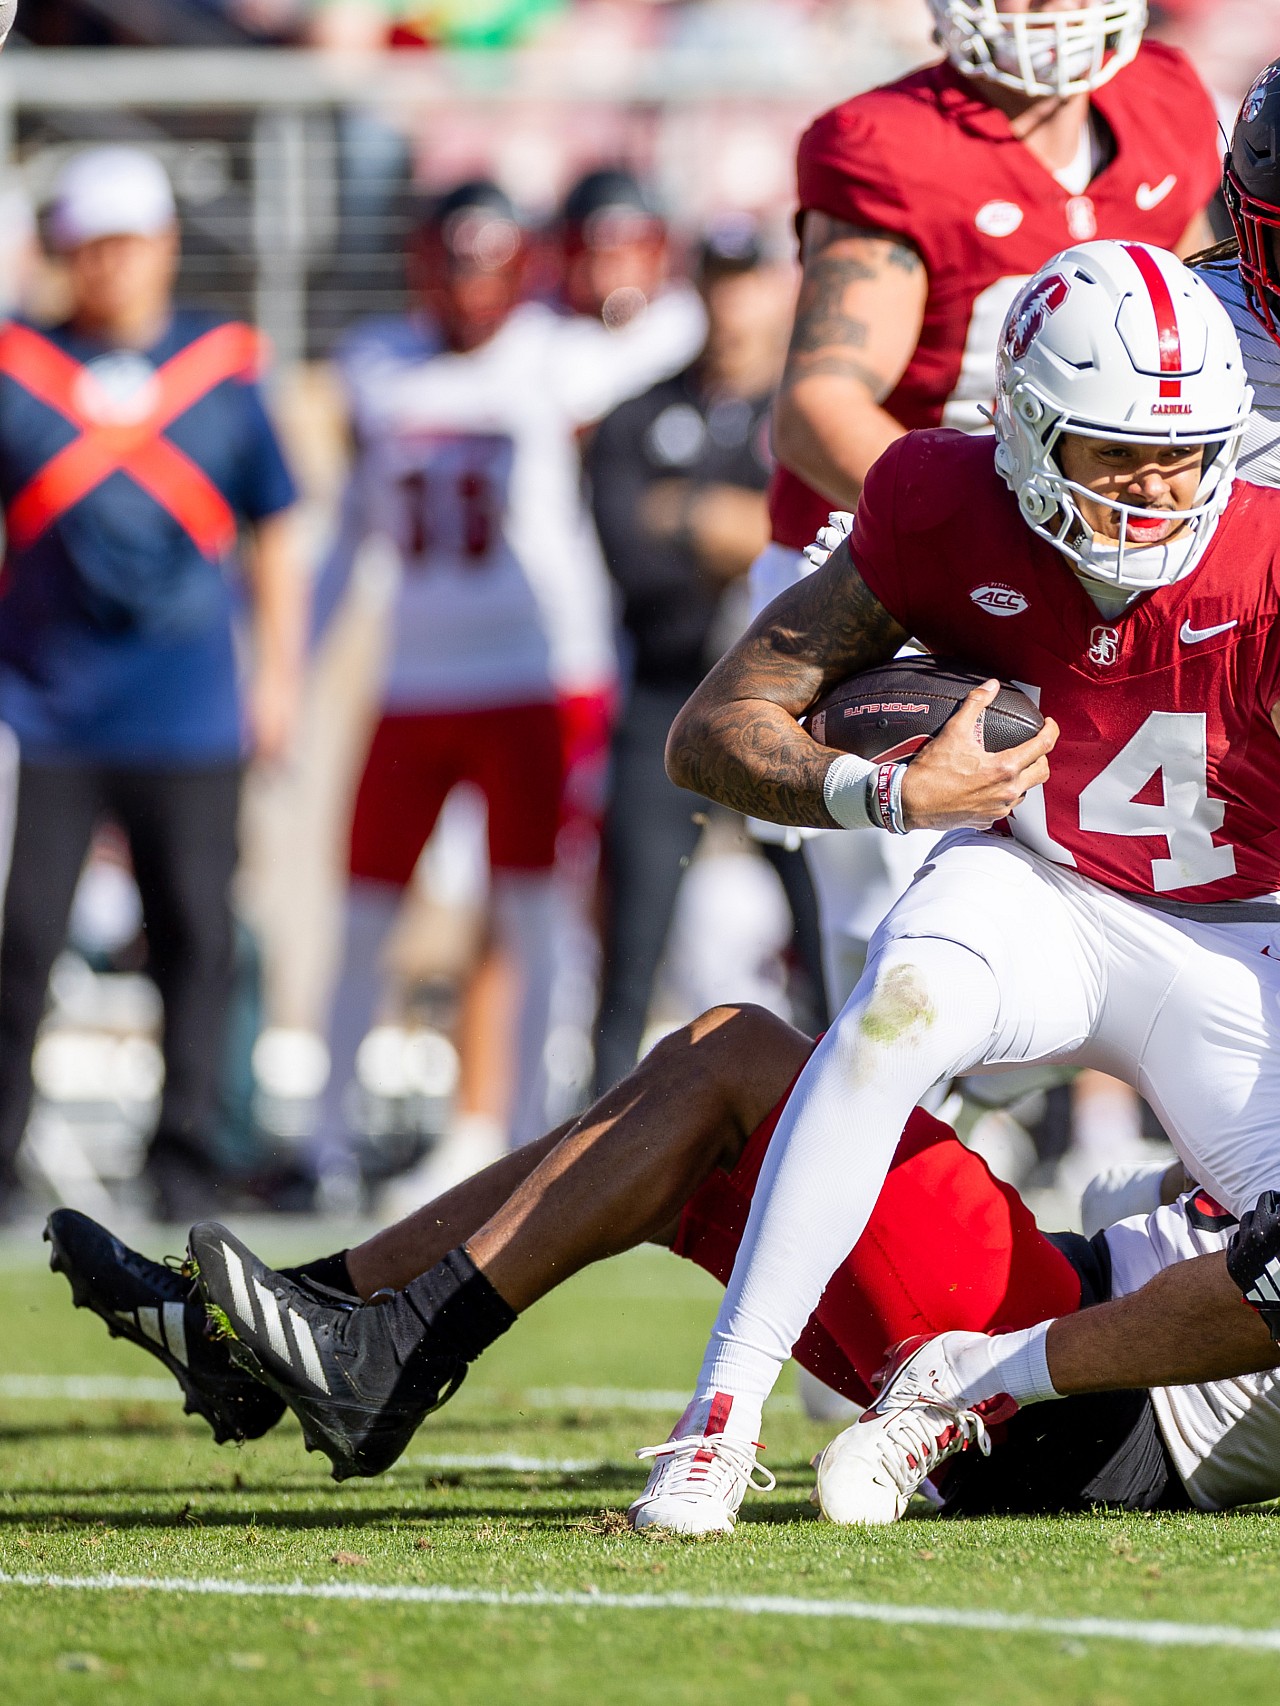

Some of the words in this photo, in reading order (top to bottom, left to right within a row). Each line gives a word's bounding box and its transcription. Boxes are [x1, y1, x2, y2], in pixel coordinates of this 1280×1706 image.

[976, 591, 1023, 608] ACC
[843, 703, 881, 718] ELITE
[881, 702, 930, 714] VAPOR
[879, 775, 888, 790] WAY
[880, 791, 888, 802] OF
